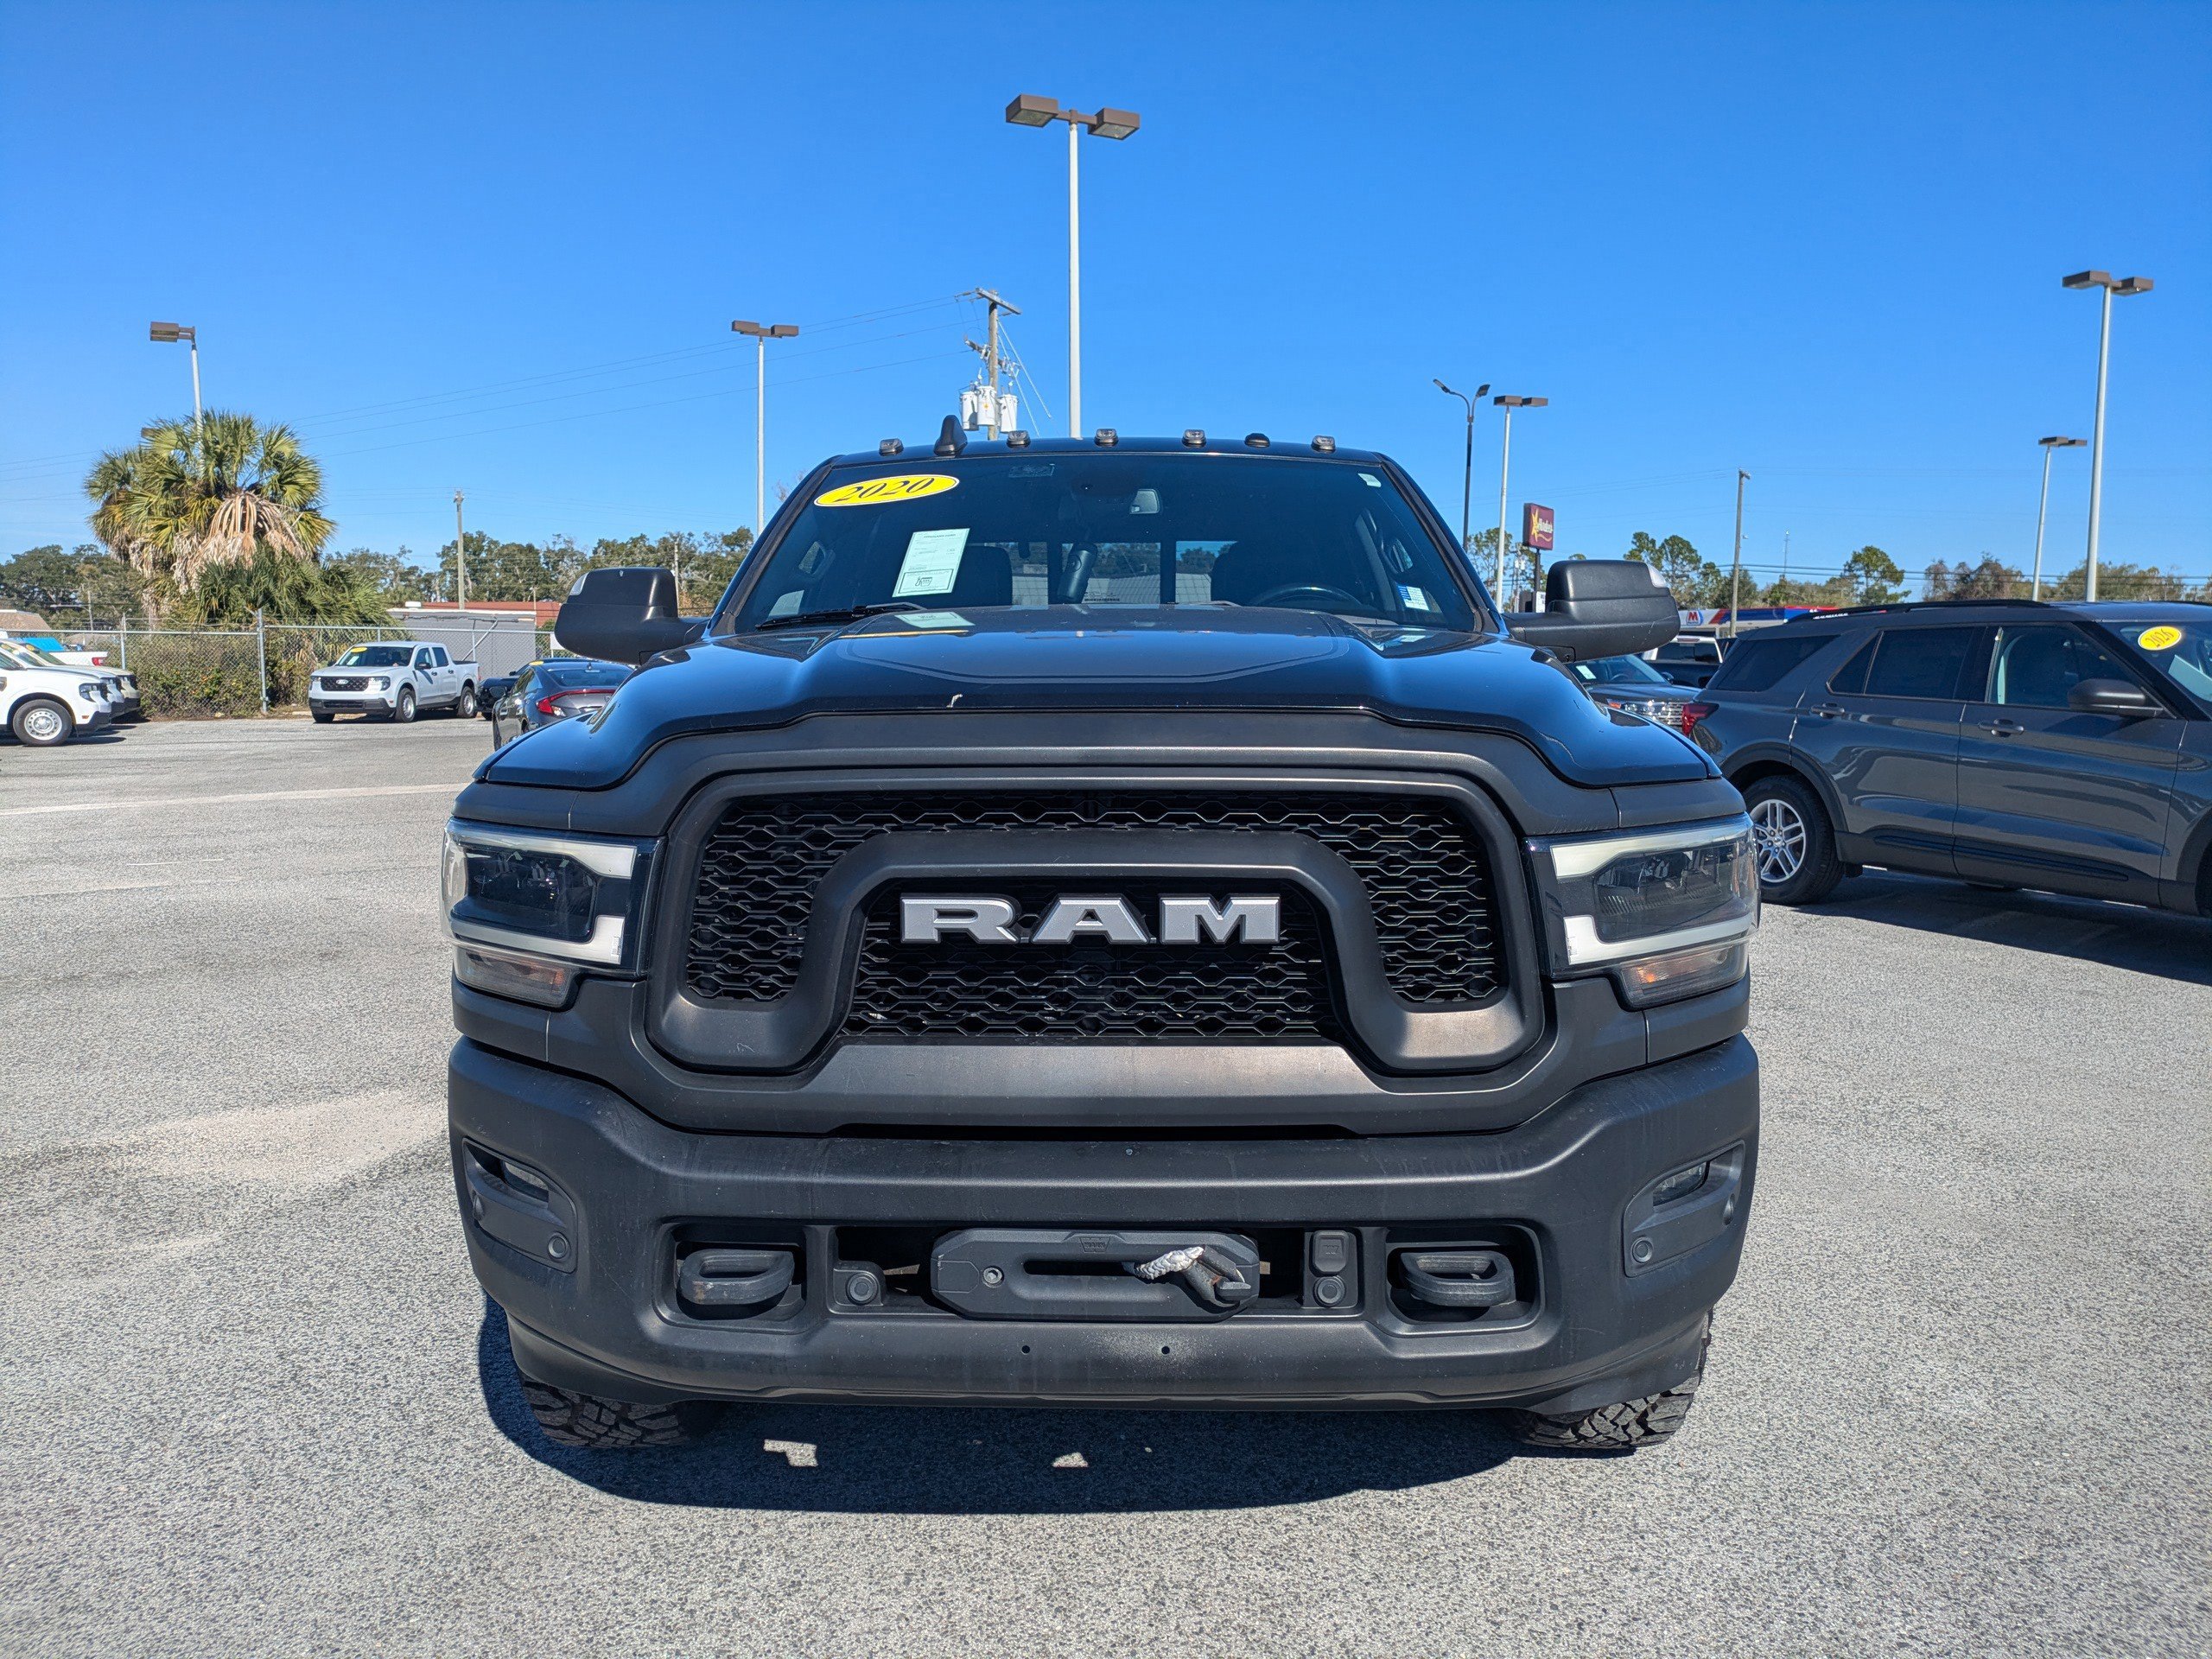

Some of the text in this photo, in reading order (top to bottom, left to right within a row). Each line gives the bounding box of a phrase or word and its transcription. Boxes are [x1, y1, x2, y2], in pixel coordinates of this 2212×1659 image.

[832, 477, 935, 503] 2020
[1688, 611, 1699, 621] M
[2145, 628, 2175, 648] 2026
[900, 893, 1281, 944] RAM
